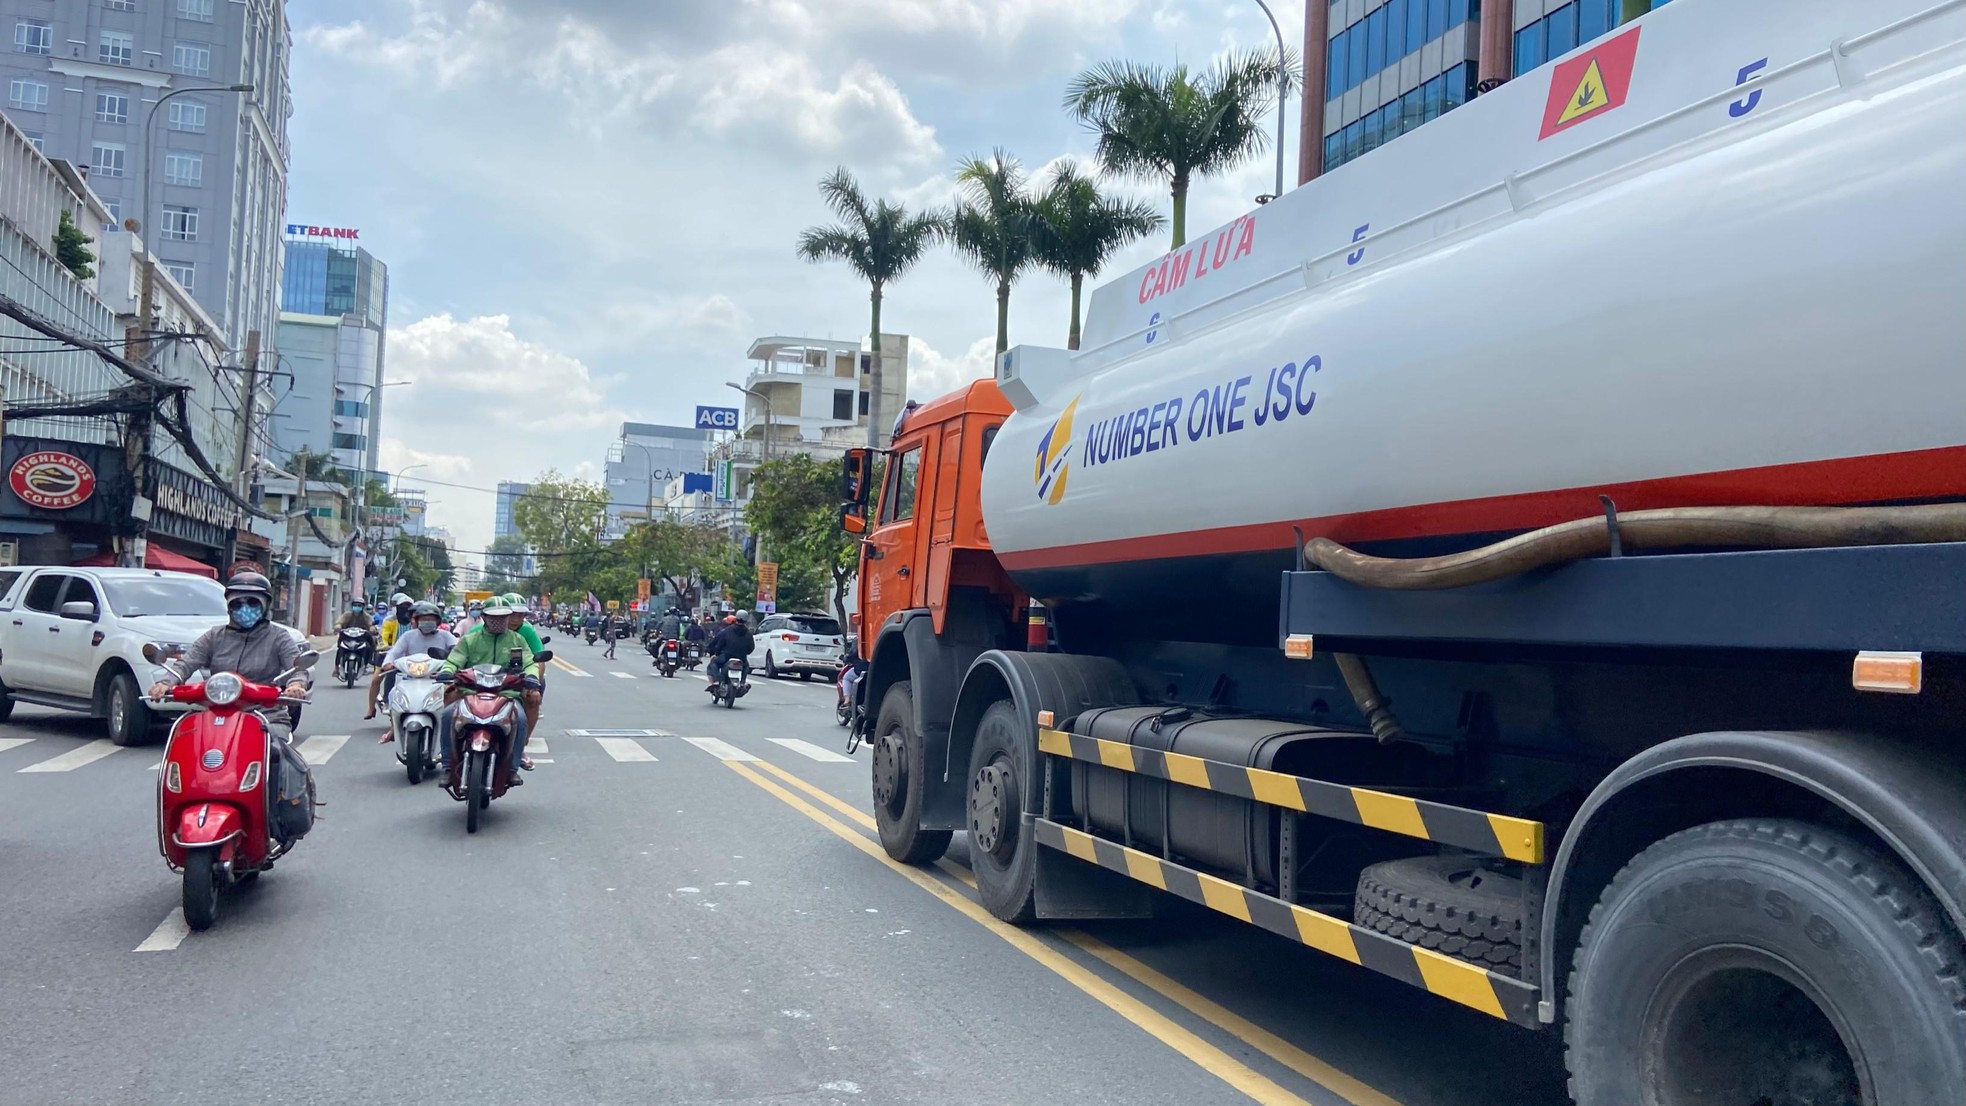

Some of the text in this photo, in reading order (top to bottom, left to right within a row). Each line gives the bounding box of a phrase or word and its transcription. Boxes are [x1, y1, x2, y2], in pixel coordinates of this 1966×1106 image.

[1728, 57, 1768, 118] 5
[287, 224, 359, 239] ETBANK
[1347, 223, 1370, 265] 5
[699, 409, 736, 427] ACB
[1083, 354, 1322, 468] NUMBER ONE JSC
[15, 454, 92, 481] HIGHLANDS
[22, 489, 82, 505] COFFEE
[157, 480, 206, 523] HIGHLANDS
